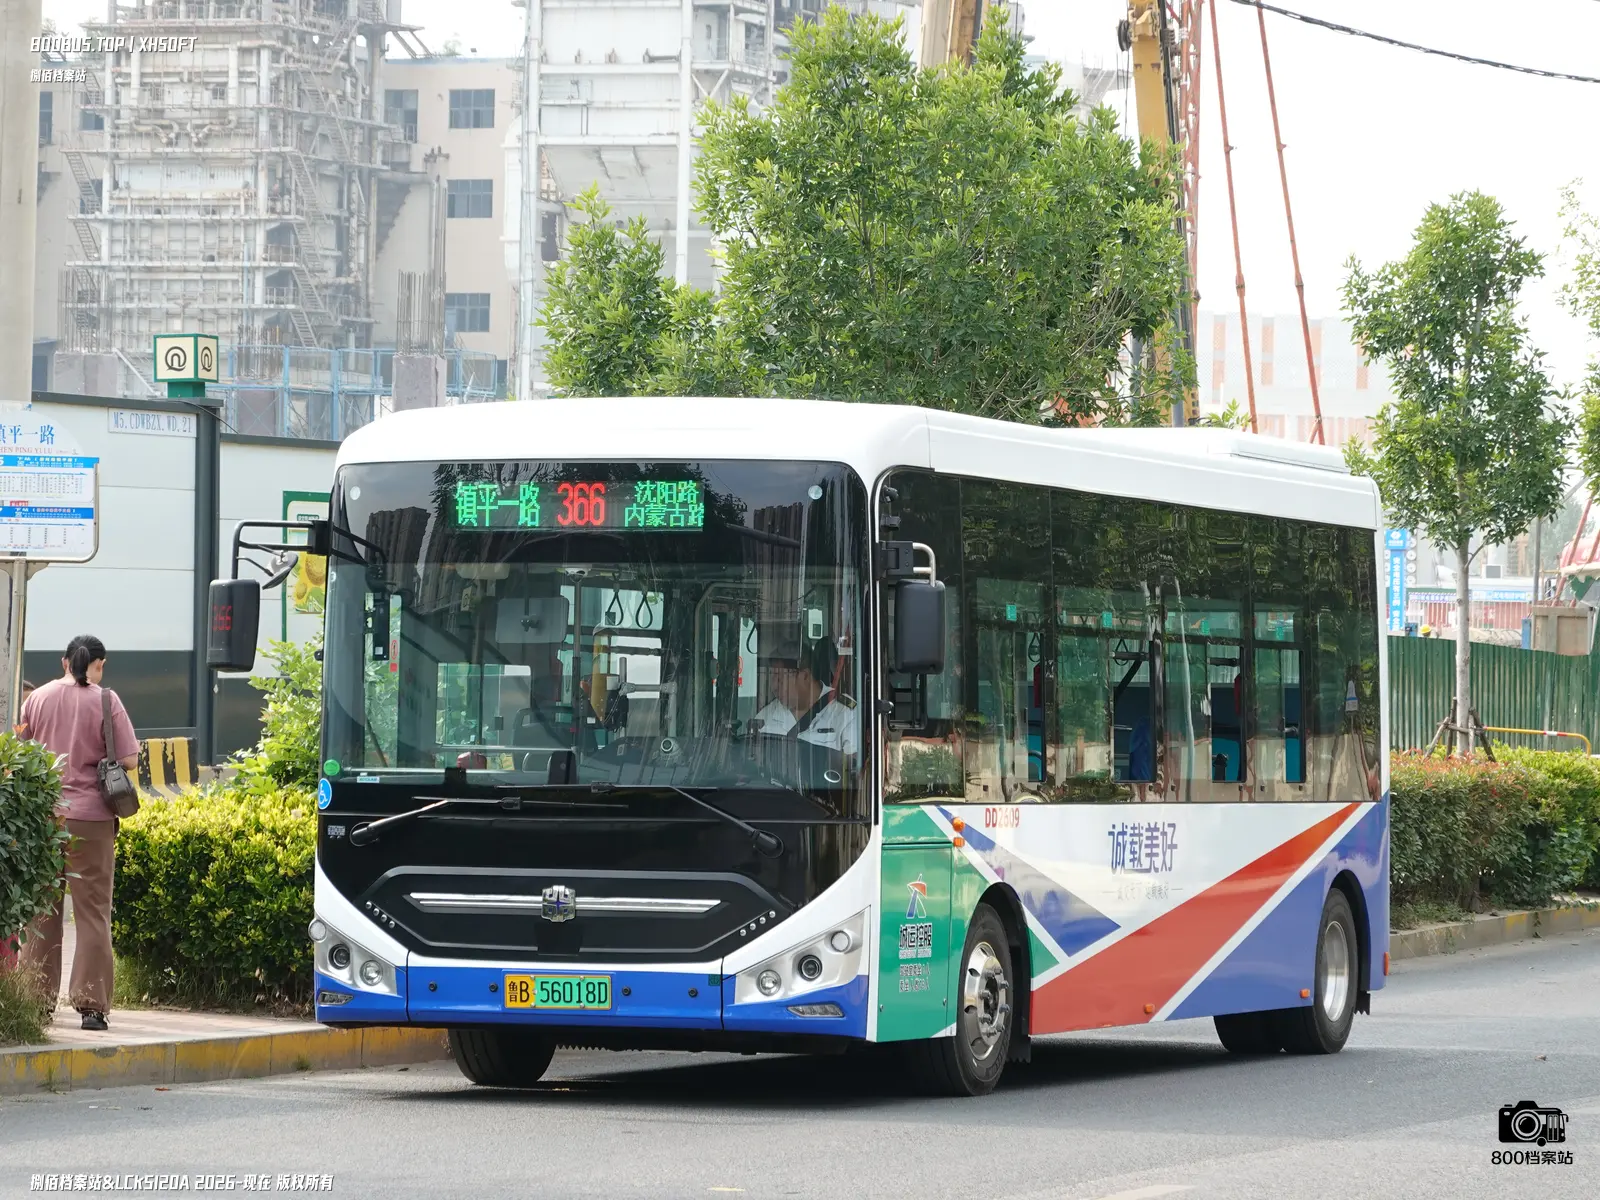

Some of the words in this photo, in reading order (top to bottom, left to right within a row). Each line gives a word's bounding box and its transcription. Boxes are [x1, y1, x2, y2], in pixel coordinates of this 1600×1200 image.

[455, 481, 541, 527] 镇平一路
[557, 483, 606, 526] 366
[634, 480, 700, 505] 沈阳路
[624, 503, 704, 528] 内蒙古路
[985, 807, 1020, 828] DD2609
[1107, 821, 1178, 874] 诚载美好
